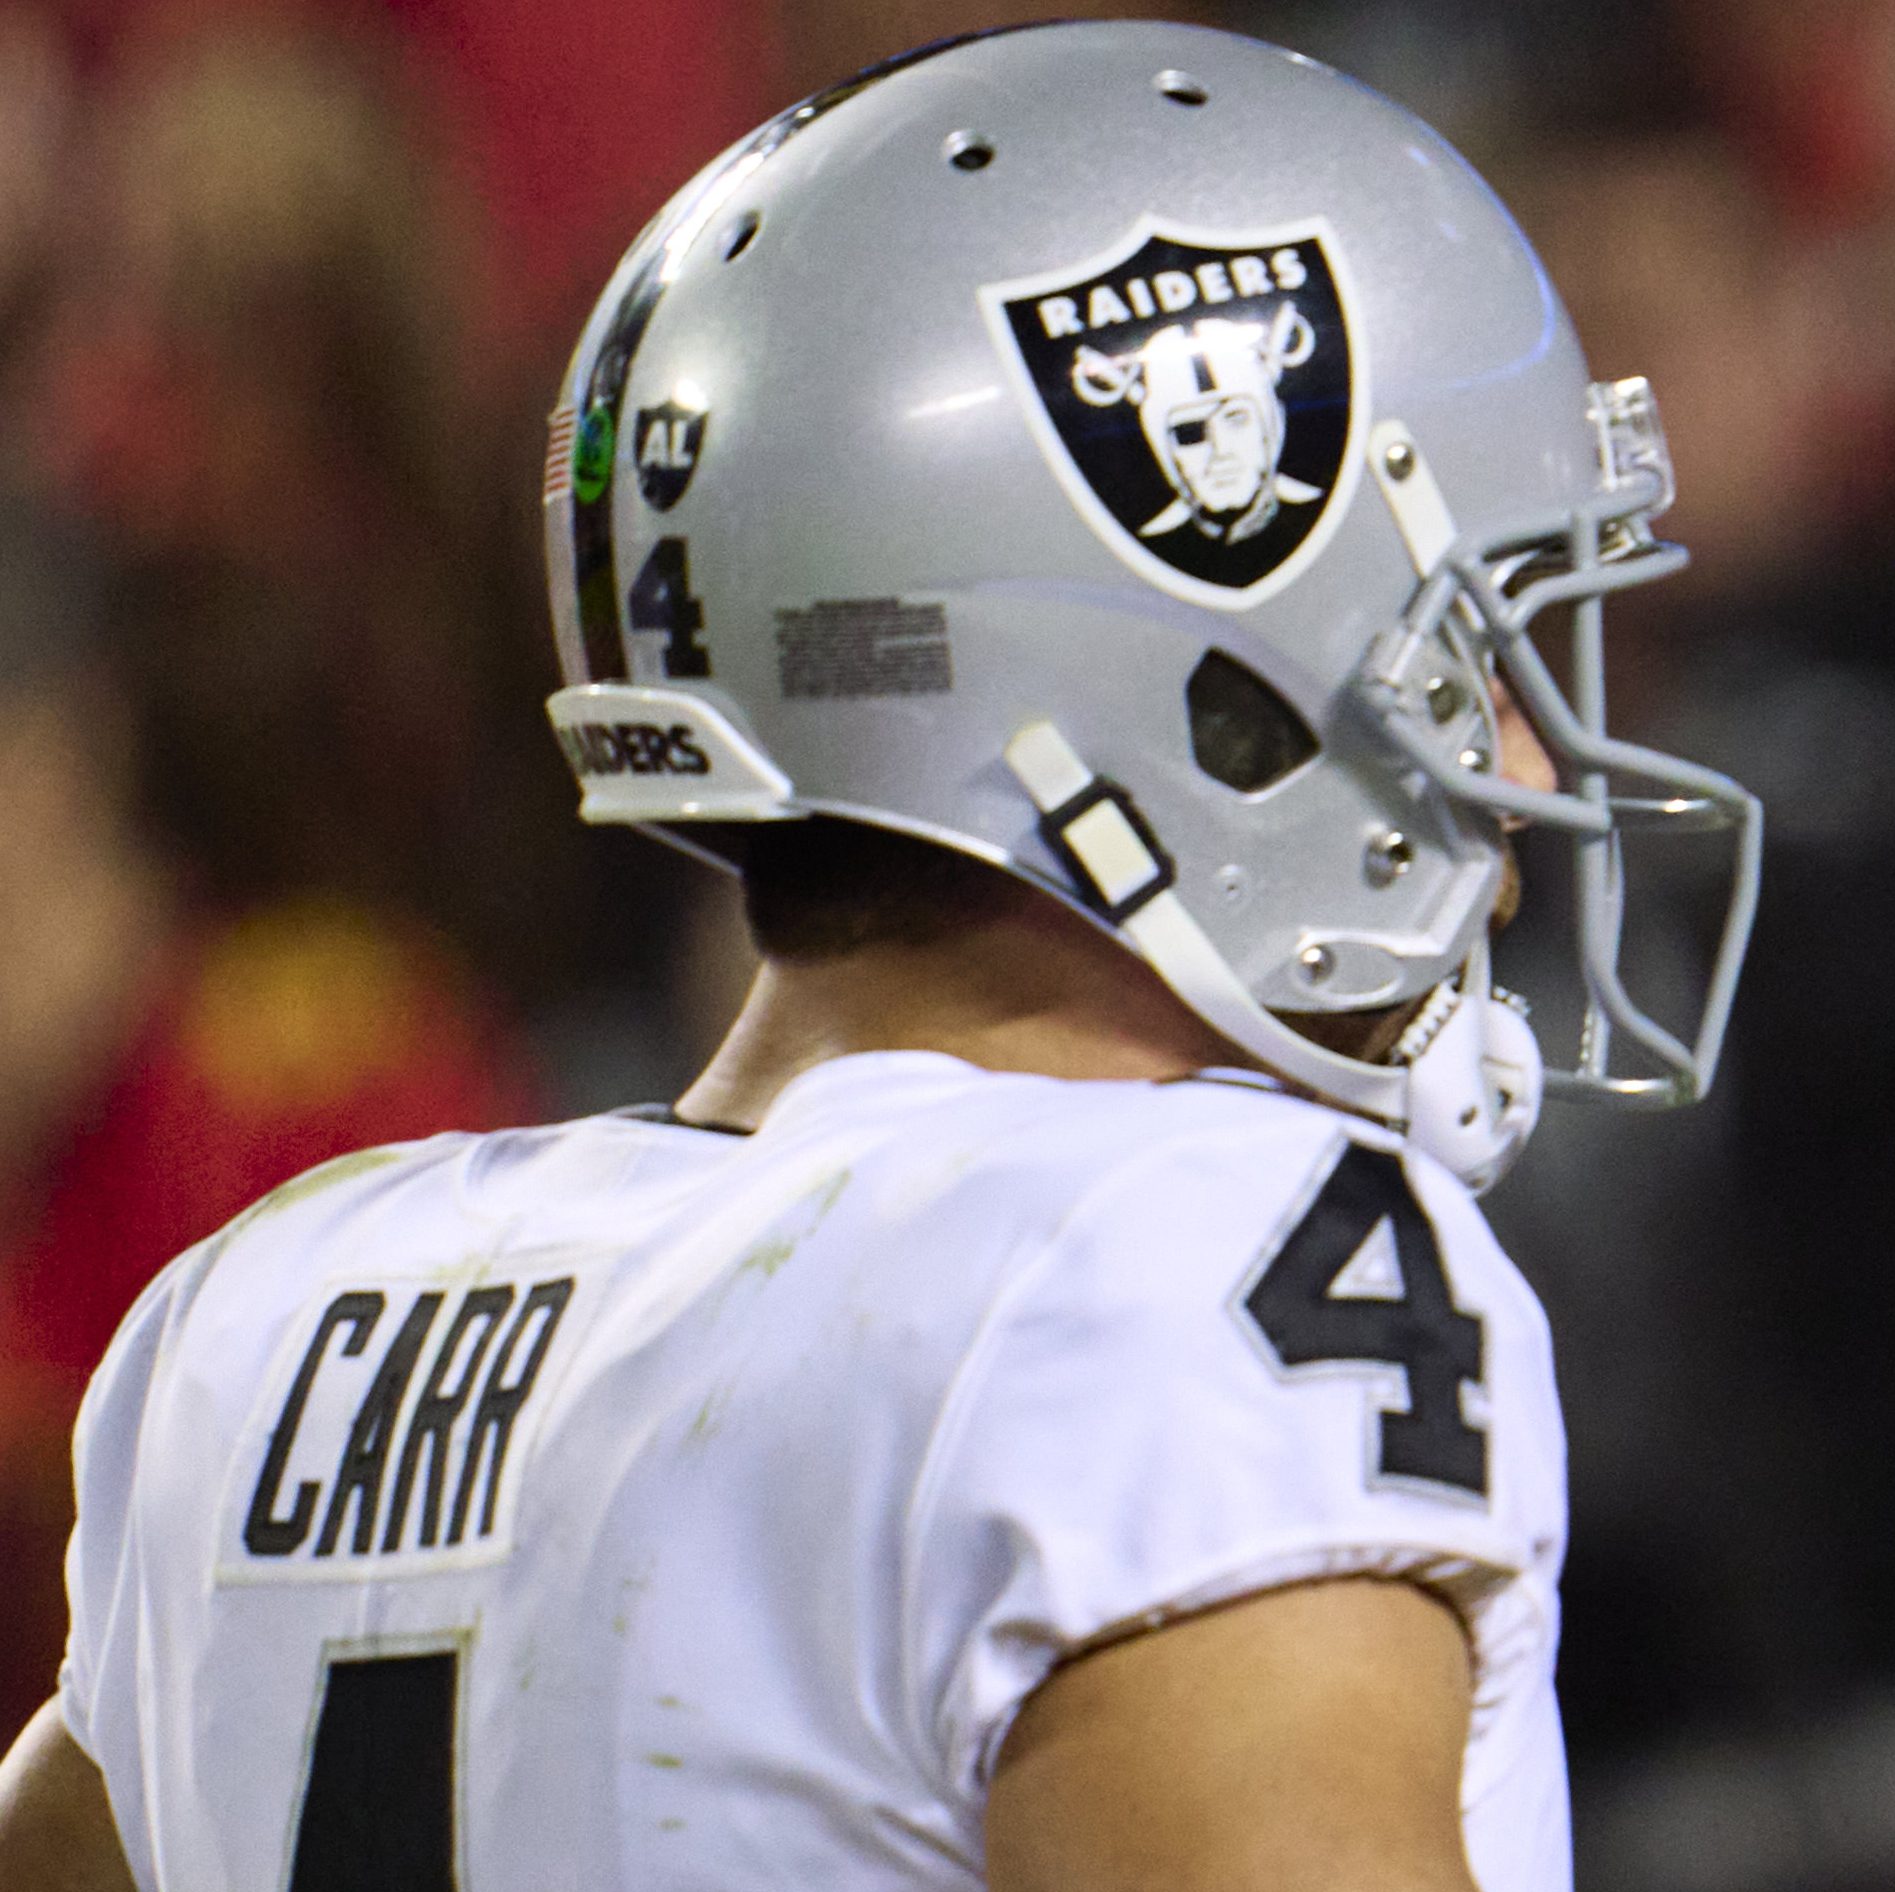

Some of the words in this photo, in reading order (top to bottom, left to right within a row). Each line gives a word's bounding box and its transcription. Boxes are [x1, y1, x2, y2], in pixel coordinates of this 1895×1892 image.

[1037, 249, 1307, 340] RAIDERS
[641, 417, 693, 469] AL
[628, 535, 713, 679] 4
[1232, 1132, 1493, 1510] 4
[242, 1274, 576, 1558] CARR
